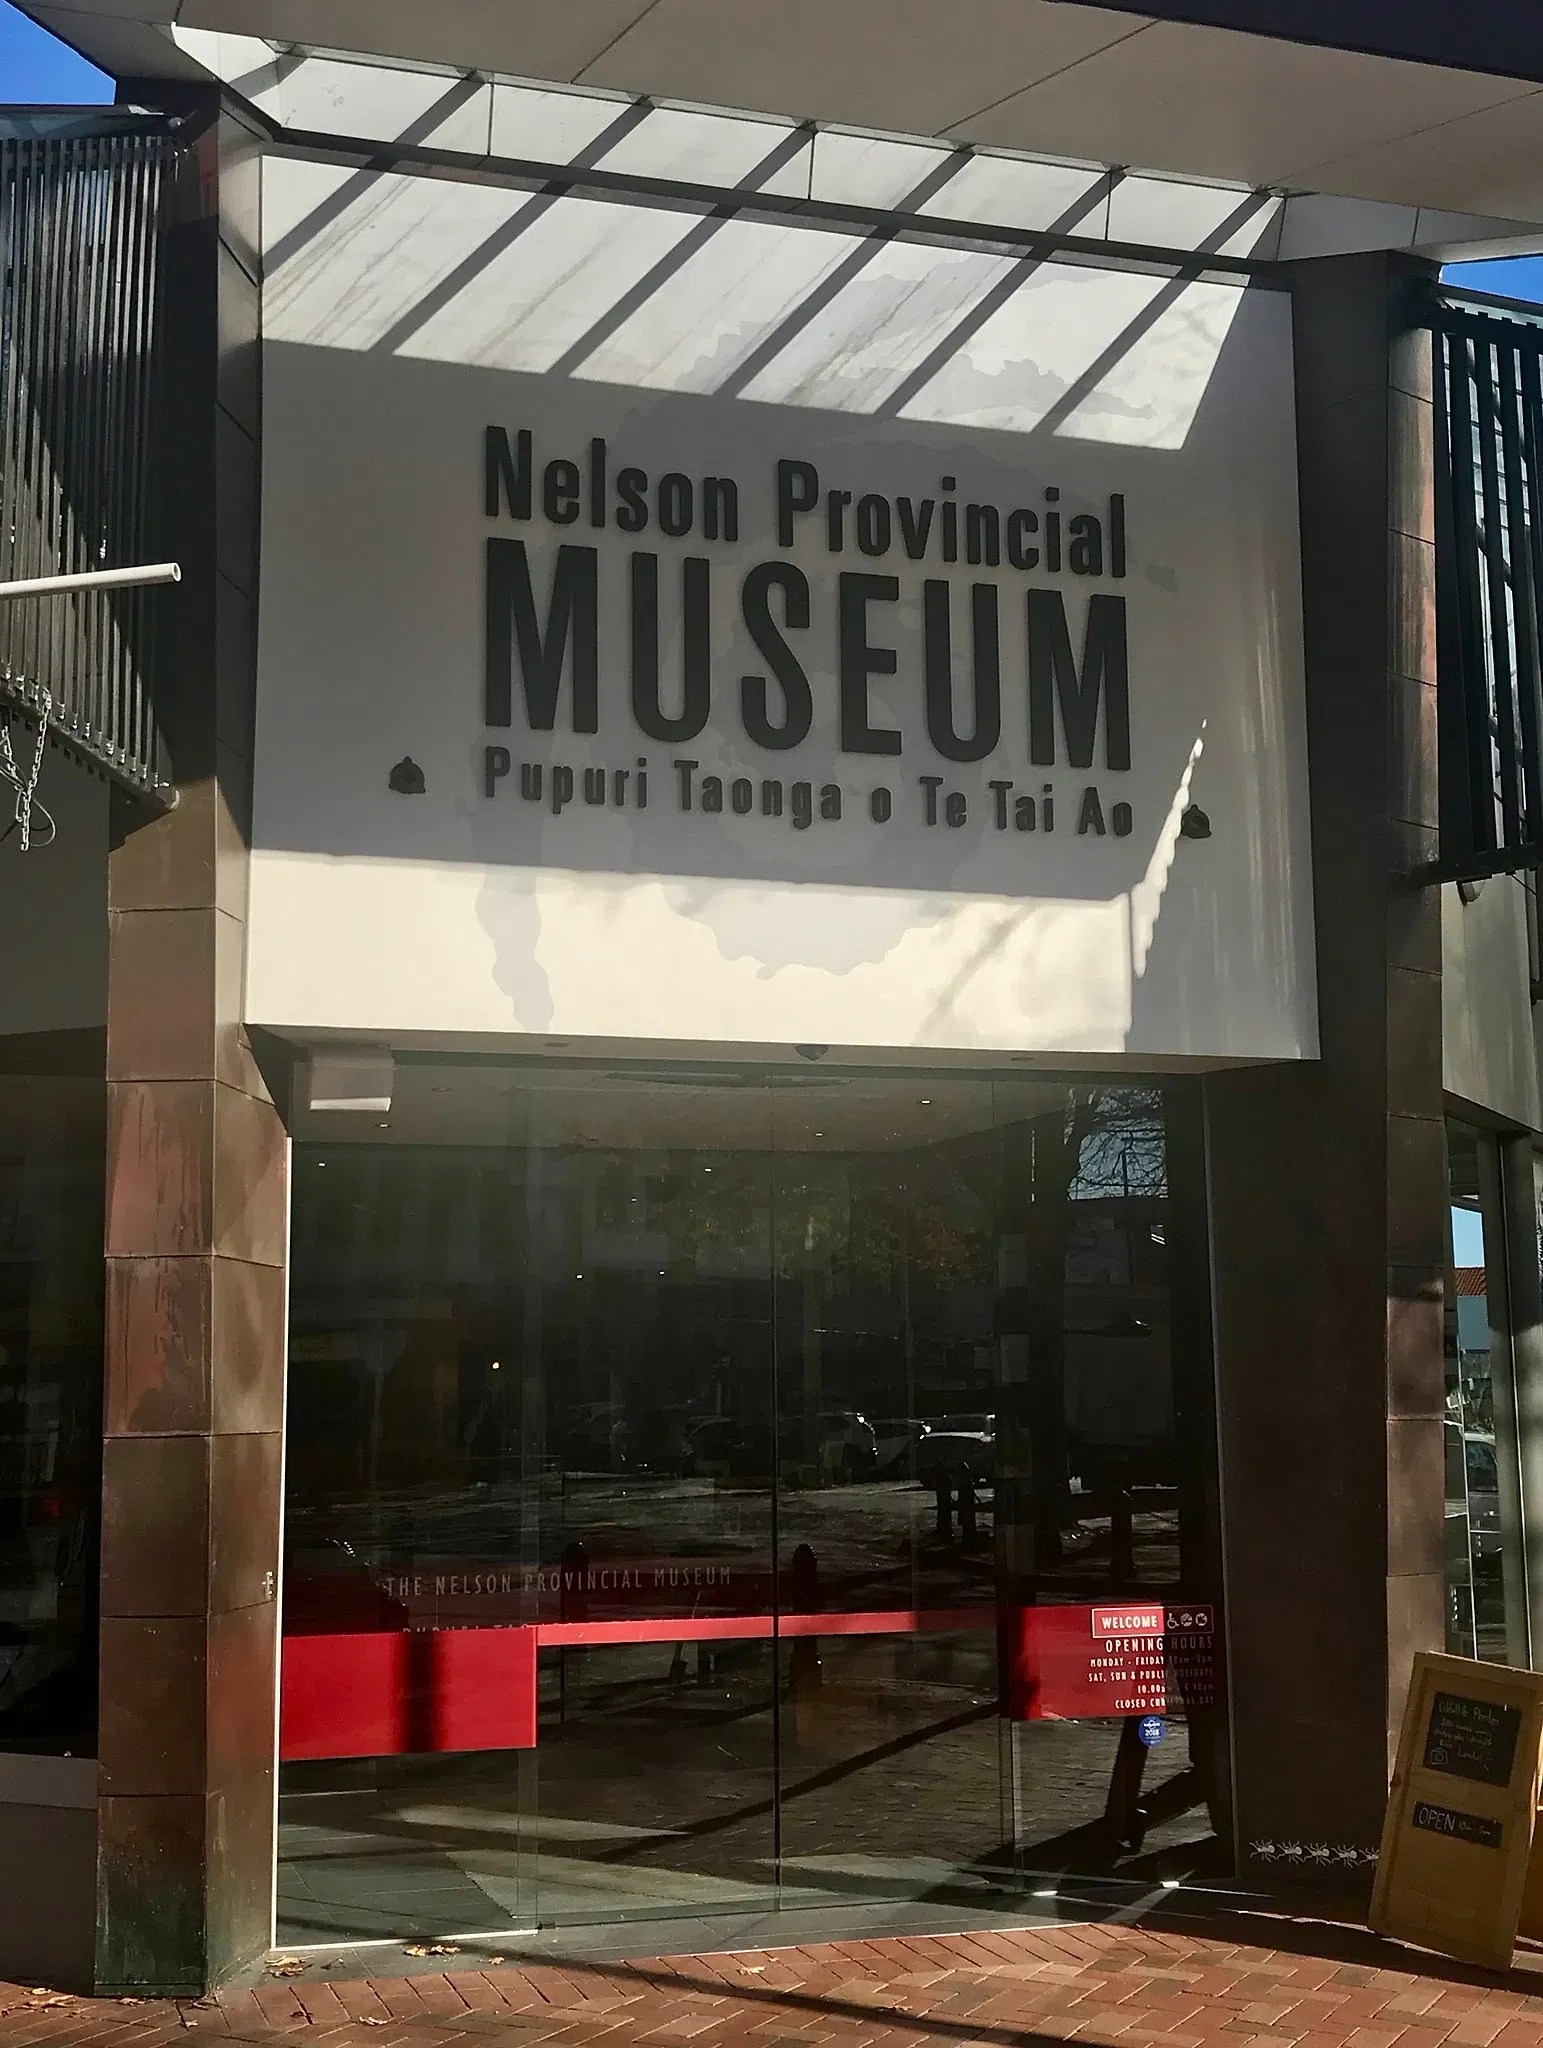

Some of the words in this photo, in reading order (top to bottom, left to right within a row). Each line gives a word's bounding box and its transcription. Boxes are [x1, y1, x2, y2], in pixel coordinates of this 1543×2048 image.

[485, 425, 738, 542] Nelson
[777, 458, 1127, 578] Provincial
[484, 536, 1132, 772] MUSEUM
[484, 745, 648, 814] Pupuri
[673, 758, 842, 831] Taonga
[868, 784, 893, 824] o
[919, 775, 967, 829] Te
[989, 779, 1055, 834] Tai
[1077, 786, 1134, 838] Ao
[386, 1576, 422, 1597] THE
[435, 1572, 512, 1596] NELSON
[523, 1568, 643, 1593] PROVINCIAL
[653, 1565, 732, 1587] MUSEUM
[1101, 1615, 1158, 1629] WELCOME
[1105, 1637, 1164, 1653] OPENING
[1171, 1636, 1213, 1649] HOURS
[1090, 1657, 1124, 1667] MONDAY
[1135, 1655, 1164, 1667] FRIDAY
[1088, 1672, 1107, 1684] SAT,
[1110, 1671, 1127, 1682] SUN
[1130, 1670, 1137, 1680] &
[1115, 1698, 1146, 1709] CLOSED
[1418, 1807, 1456, 1832] OPEN
